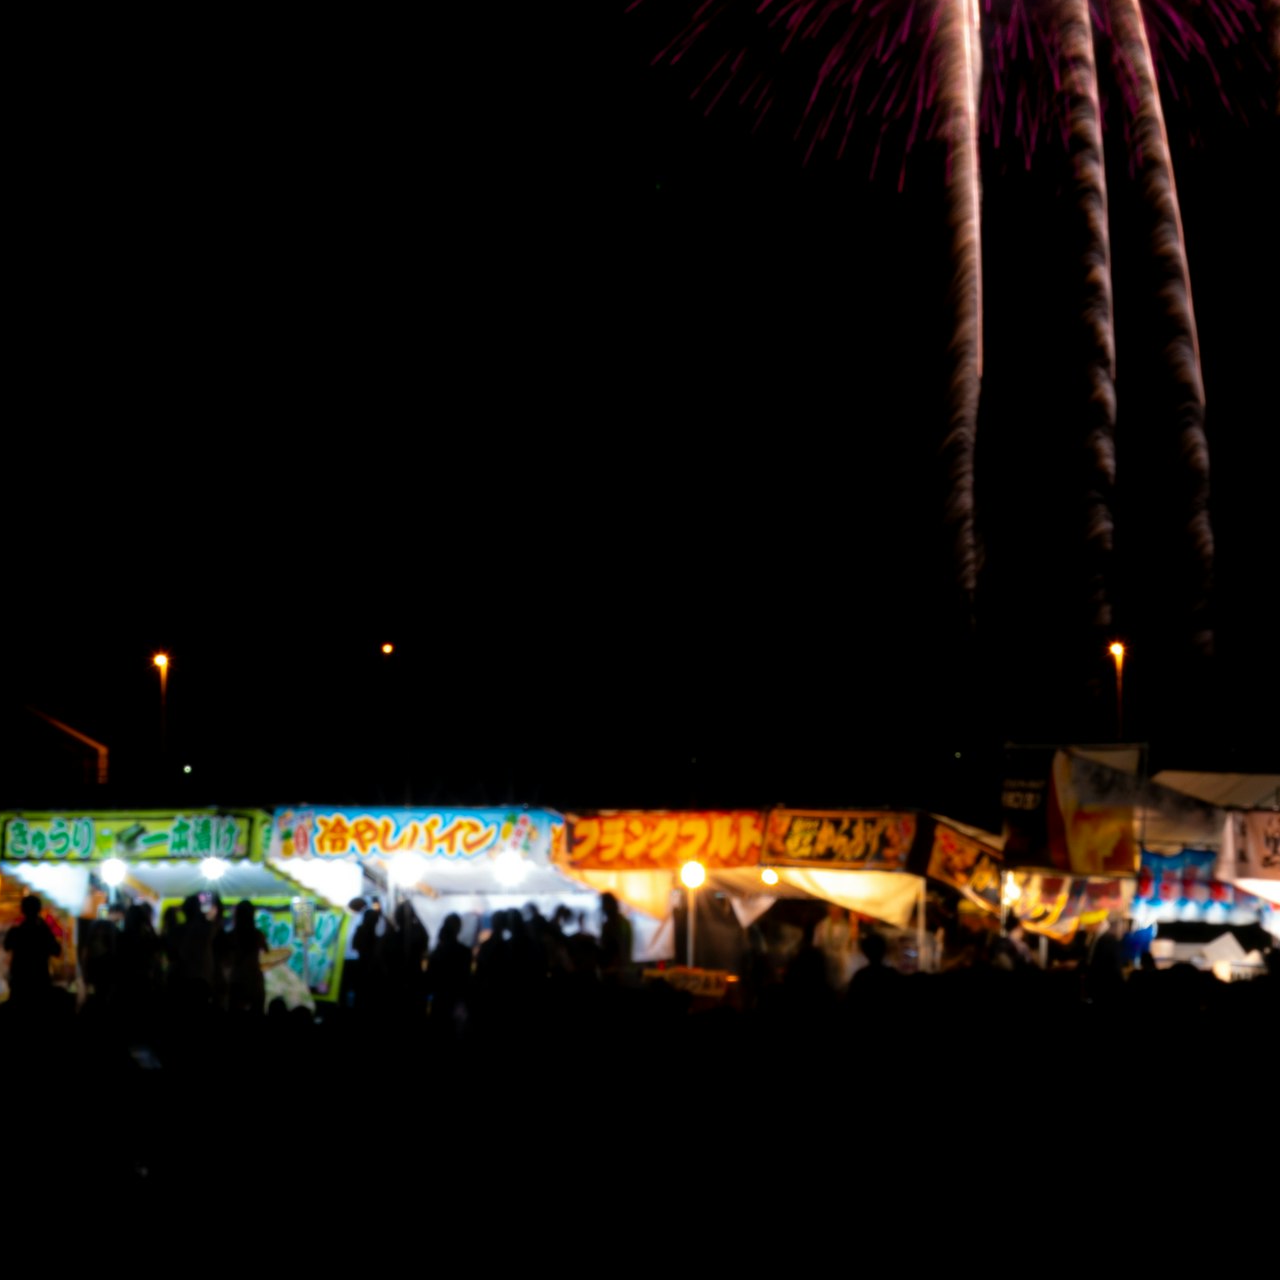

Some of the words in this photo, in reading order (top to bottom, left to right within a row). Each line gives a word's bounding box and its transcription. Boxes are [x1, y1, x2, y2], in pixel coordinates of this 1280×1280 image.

[8, 817, 94, 858] きゅうり
[140, 815, 238, 857] 一本漬け
[315, 814, 497, 856] 冷やしパイン
[572, 815, 762, 861] フランクフルト
